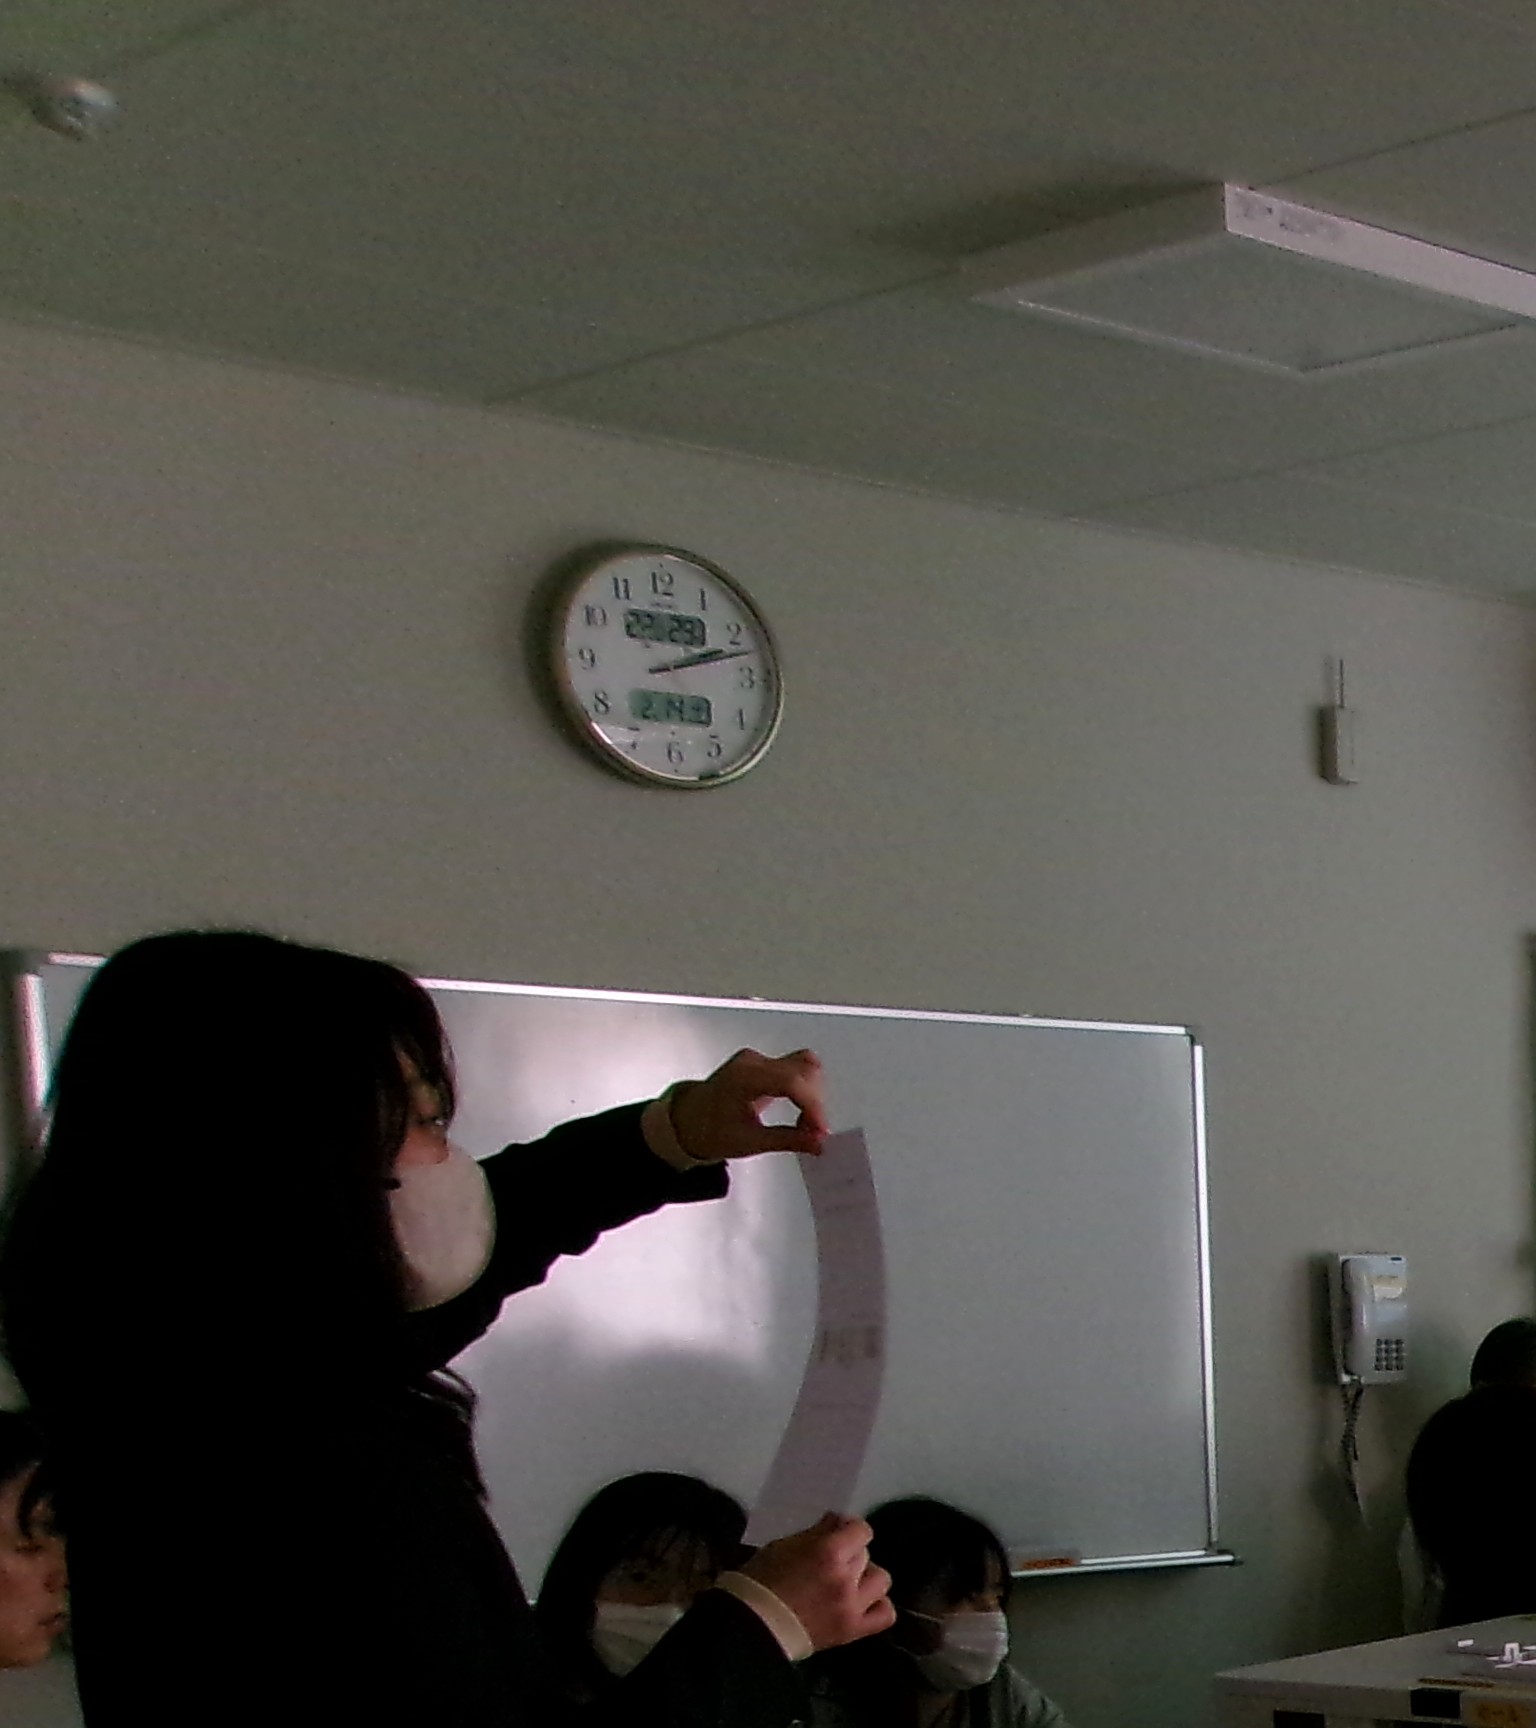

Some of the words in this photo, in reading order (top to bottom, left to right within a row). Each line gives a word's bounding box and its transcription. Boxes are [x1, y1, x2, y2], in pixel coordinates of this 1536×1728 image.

[613, 577, 630, 600] 11
[651, 571, 674, 597] 12
[700, 588, 708, 611] 1
[727, 622, 742, 646] 2
[578, 648, 596, 670] 9
[739, 666, 756, 689] 3
[594, 690, 611, 715] 8
[667, 740, 684, 764] 6
